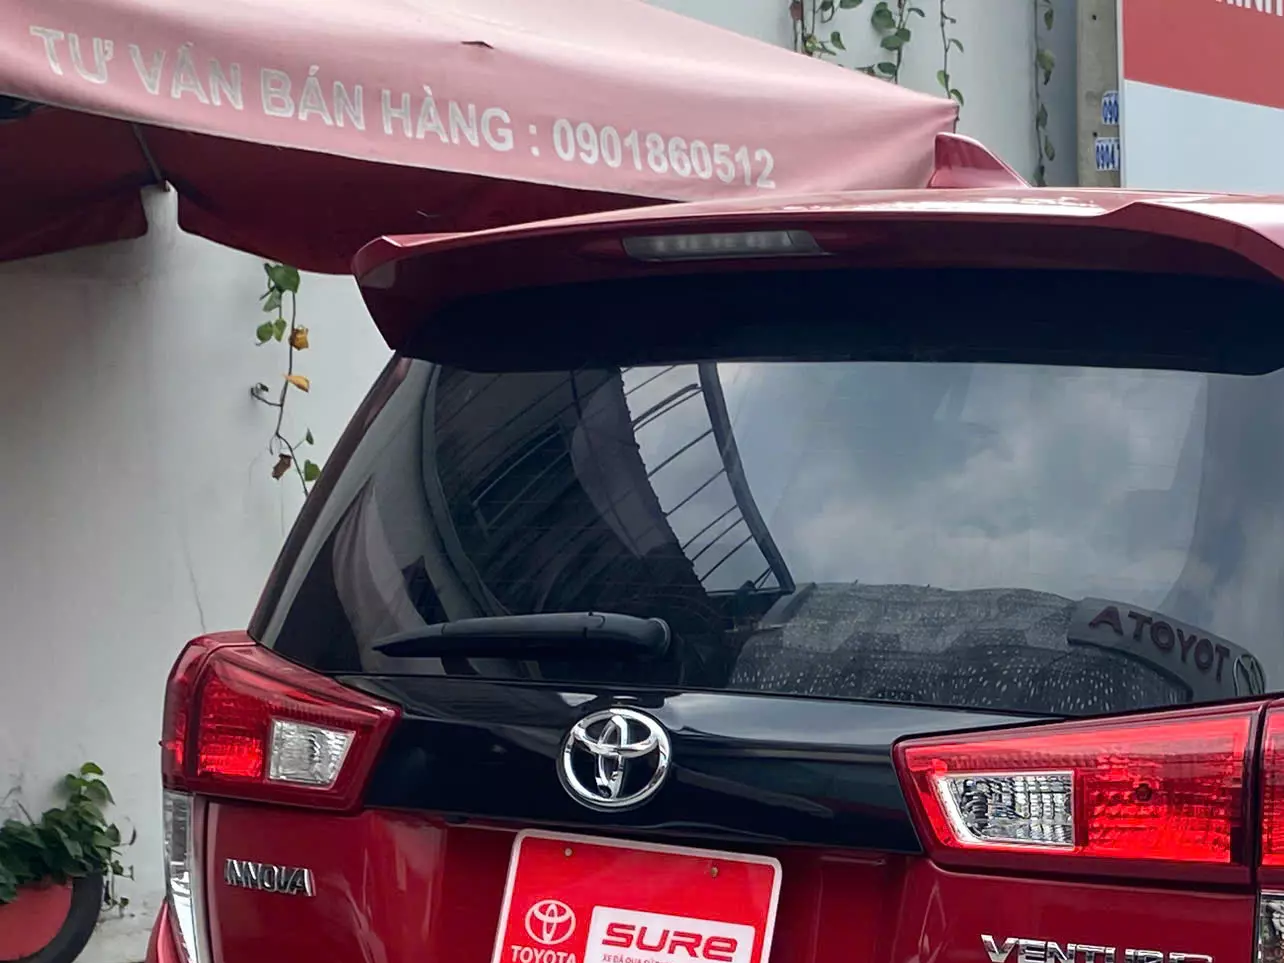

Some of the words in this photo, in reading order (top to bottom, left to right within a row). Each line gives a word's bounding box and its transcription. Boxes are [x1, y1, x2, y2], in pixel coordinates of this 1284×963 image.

[260, 65, 366, 131] BÁN
[381, 84, 514, 152] HÀNG
[552, 118, 776, 190] 0901860512
